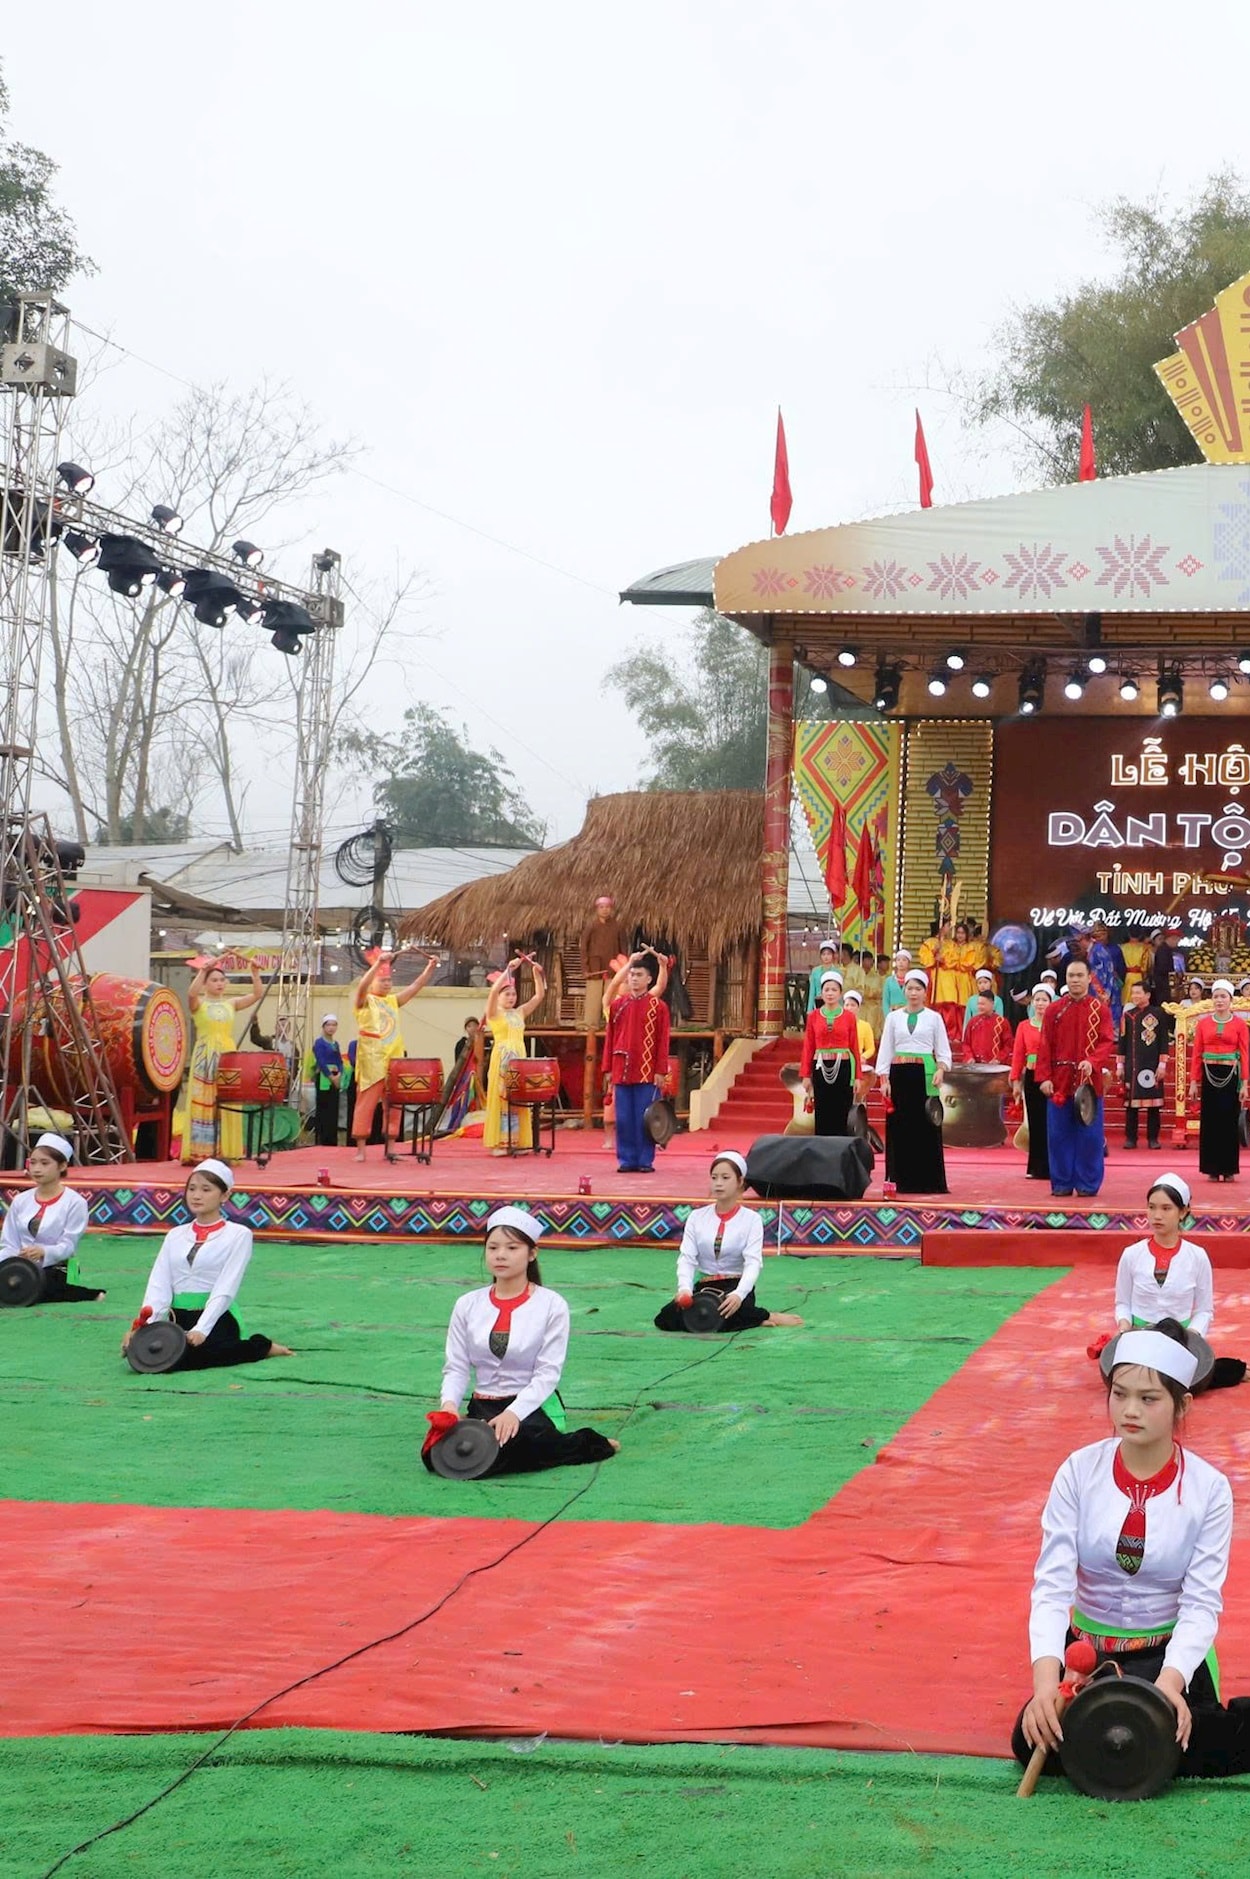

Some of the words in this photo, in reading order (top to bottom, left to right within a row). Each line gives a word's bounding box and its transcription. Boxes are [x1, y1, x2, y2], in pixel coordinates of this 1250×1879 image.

[1110, 737, 1169, 786] LỄ
[1048, 800, 1167, 848] DÂN
[1096, 863, 1164, 895] TỈNH
[1188, 908, 1218, 931] Hộ
